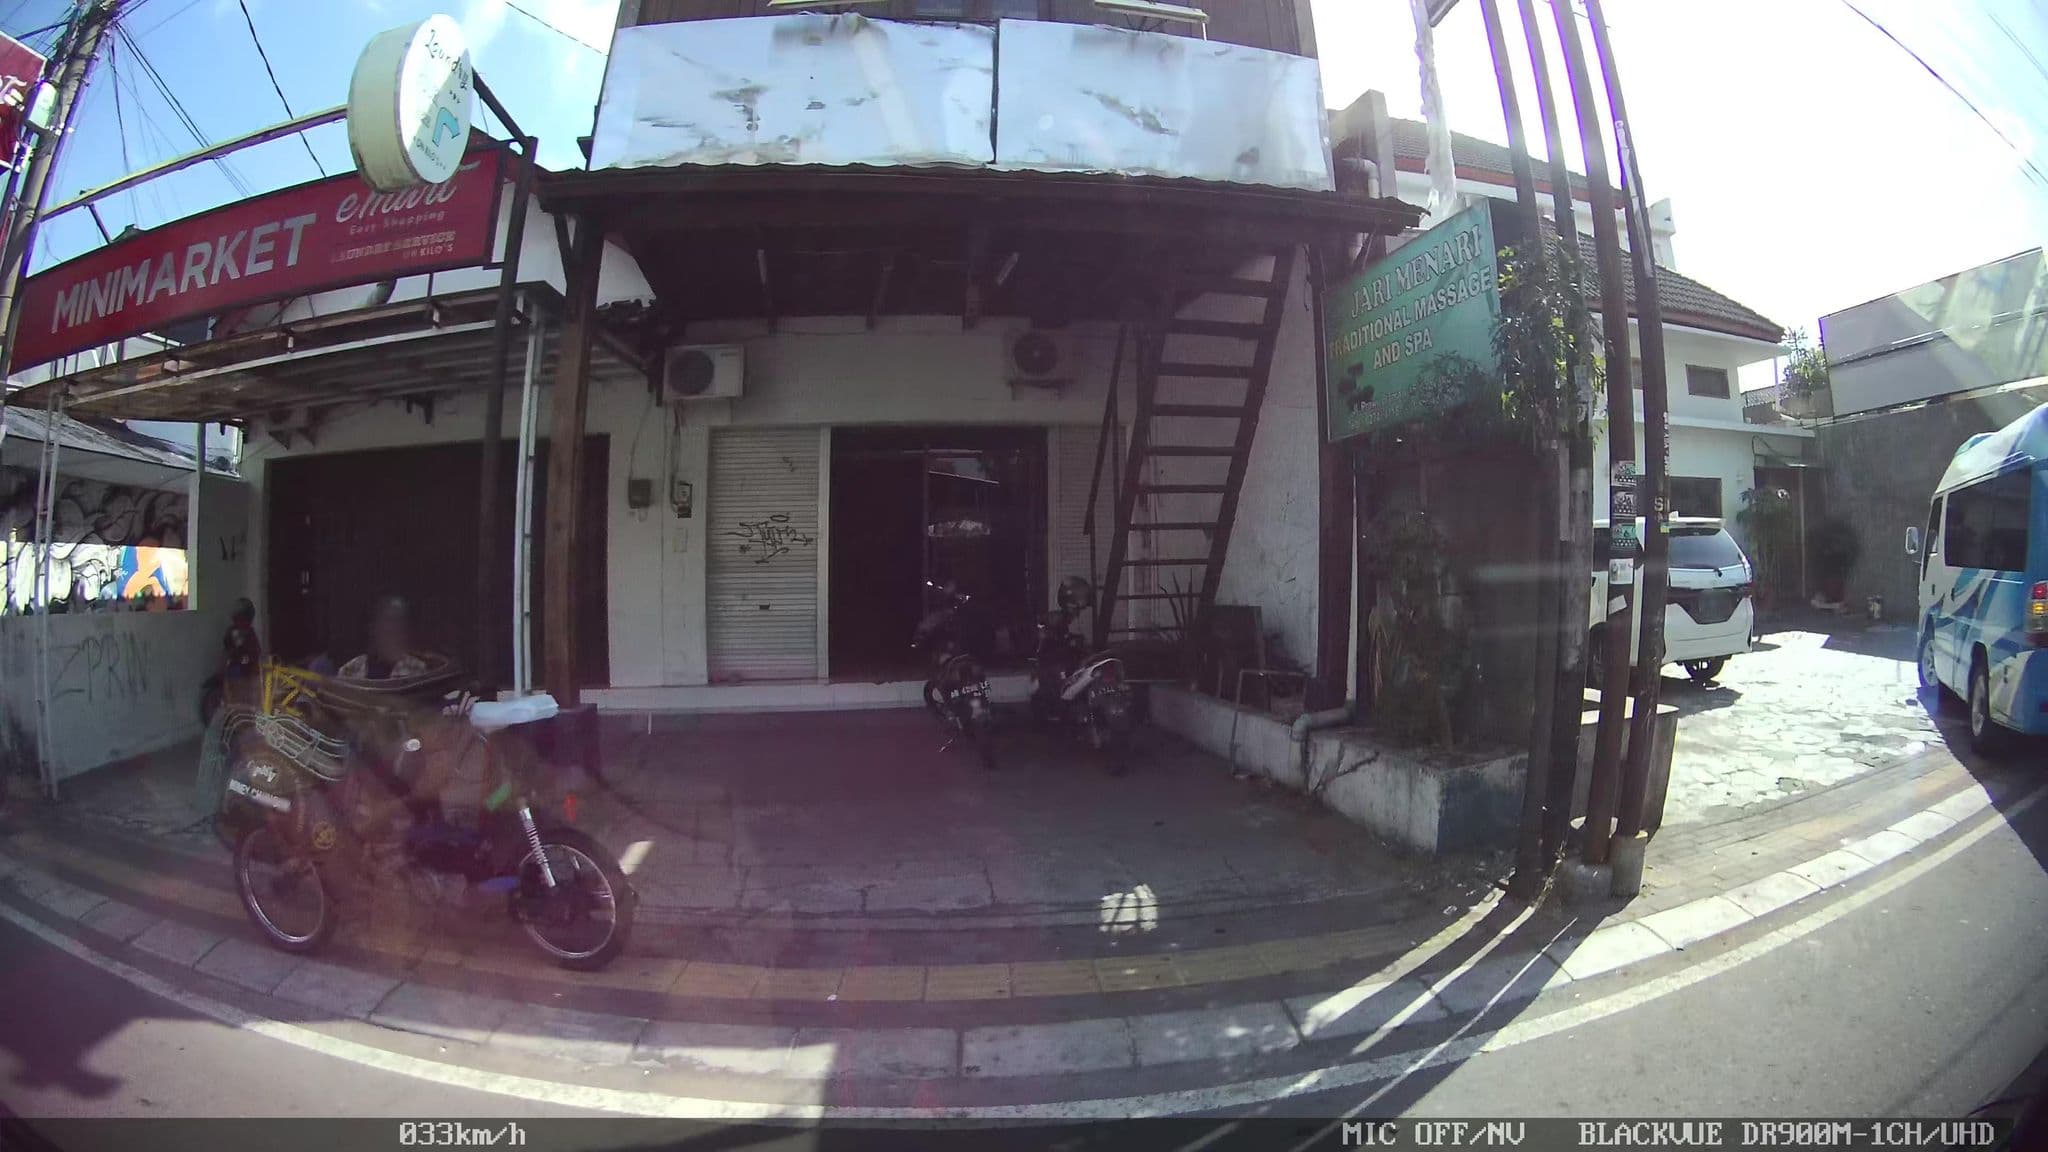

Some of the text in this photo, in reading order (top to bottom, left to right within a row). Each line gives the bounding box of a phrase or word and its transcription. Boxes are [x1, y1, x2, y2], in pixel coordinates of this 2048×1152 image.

[51, 213, 317, 335] MINIMARKET
[1329, 264, 1493, 359] TRADITIONAL MASSAGE
[1351, 223, 1483, 319] JARI MENARI
[1373, 327, 1433, 371] AND SPA
